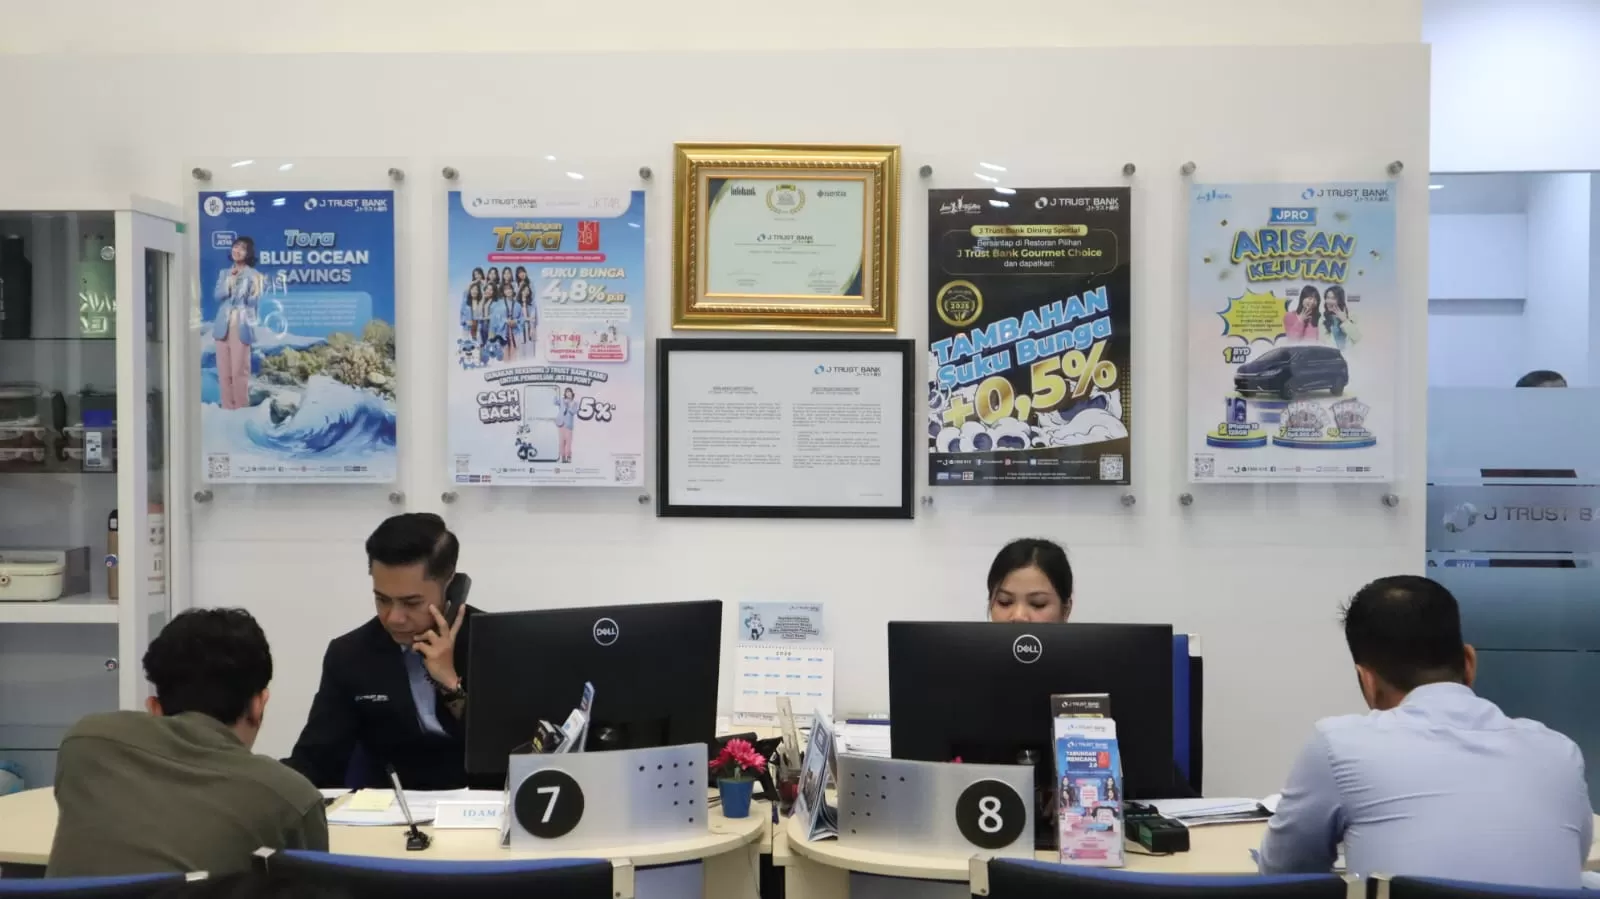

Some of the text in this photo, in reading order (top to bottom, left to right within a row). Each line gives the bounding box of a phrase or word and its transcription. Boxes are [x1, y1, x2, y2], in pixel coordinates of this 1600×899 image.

[1317, 189, 1389, 197] J TRUST BANK
[319, 198, 387, 207] J TRUST BANK
[1050, 198, 1119, 206] J TRUST BANK
[225, 206, 256, 214] change
[1276, 210, 1309, 220] JPRO
[284, 229, 335, 248] Tora
[493, 226, 562, 251] Tora
[1058, 238, 1082, 246] Pilihan
[1232, 228, 1355, 262] ARISAN
[259, 250, 369, 265] BLUE OCEAN
[956, 248, 1102, 258] J Trust Bank Gourmet Choice
[1019, 260, 1055, 268] dapatkan:
[1249, 259, 1348, 281] KEJUTAN
[277, 268, 352, 283] SAVINGS
[542, 267, 625, 278] SUKU BUNGA
[541, 279, 606, 304] 4,8%
[932, 286, 1109, 365] TAMBAHAN
[937, 316, 1112, 390] Suku Bunga
[1223, 347, 1232, 364] 1
[943, 340, 1117, 429] +0,5%
[476, 389, 520, 406] CASH
[478, 403, 521, 422] BACK
[1484, 506, 1497, 521] J
[1504, 506, 1568, 521] TRUST
[597, 627, 616, 636] DELL
[1016, 644, 1039, 654] DELL
[537, 785, 561, 824] 7
[463, 809, 496, 817] IDAM
[978, 795, 1003, 834] 8
